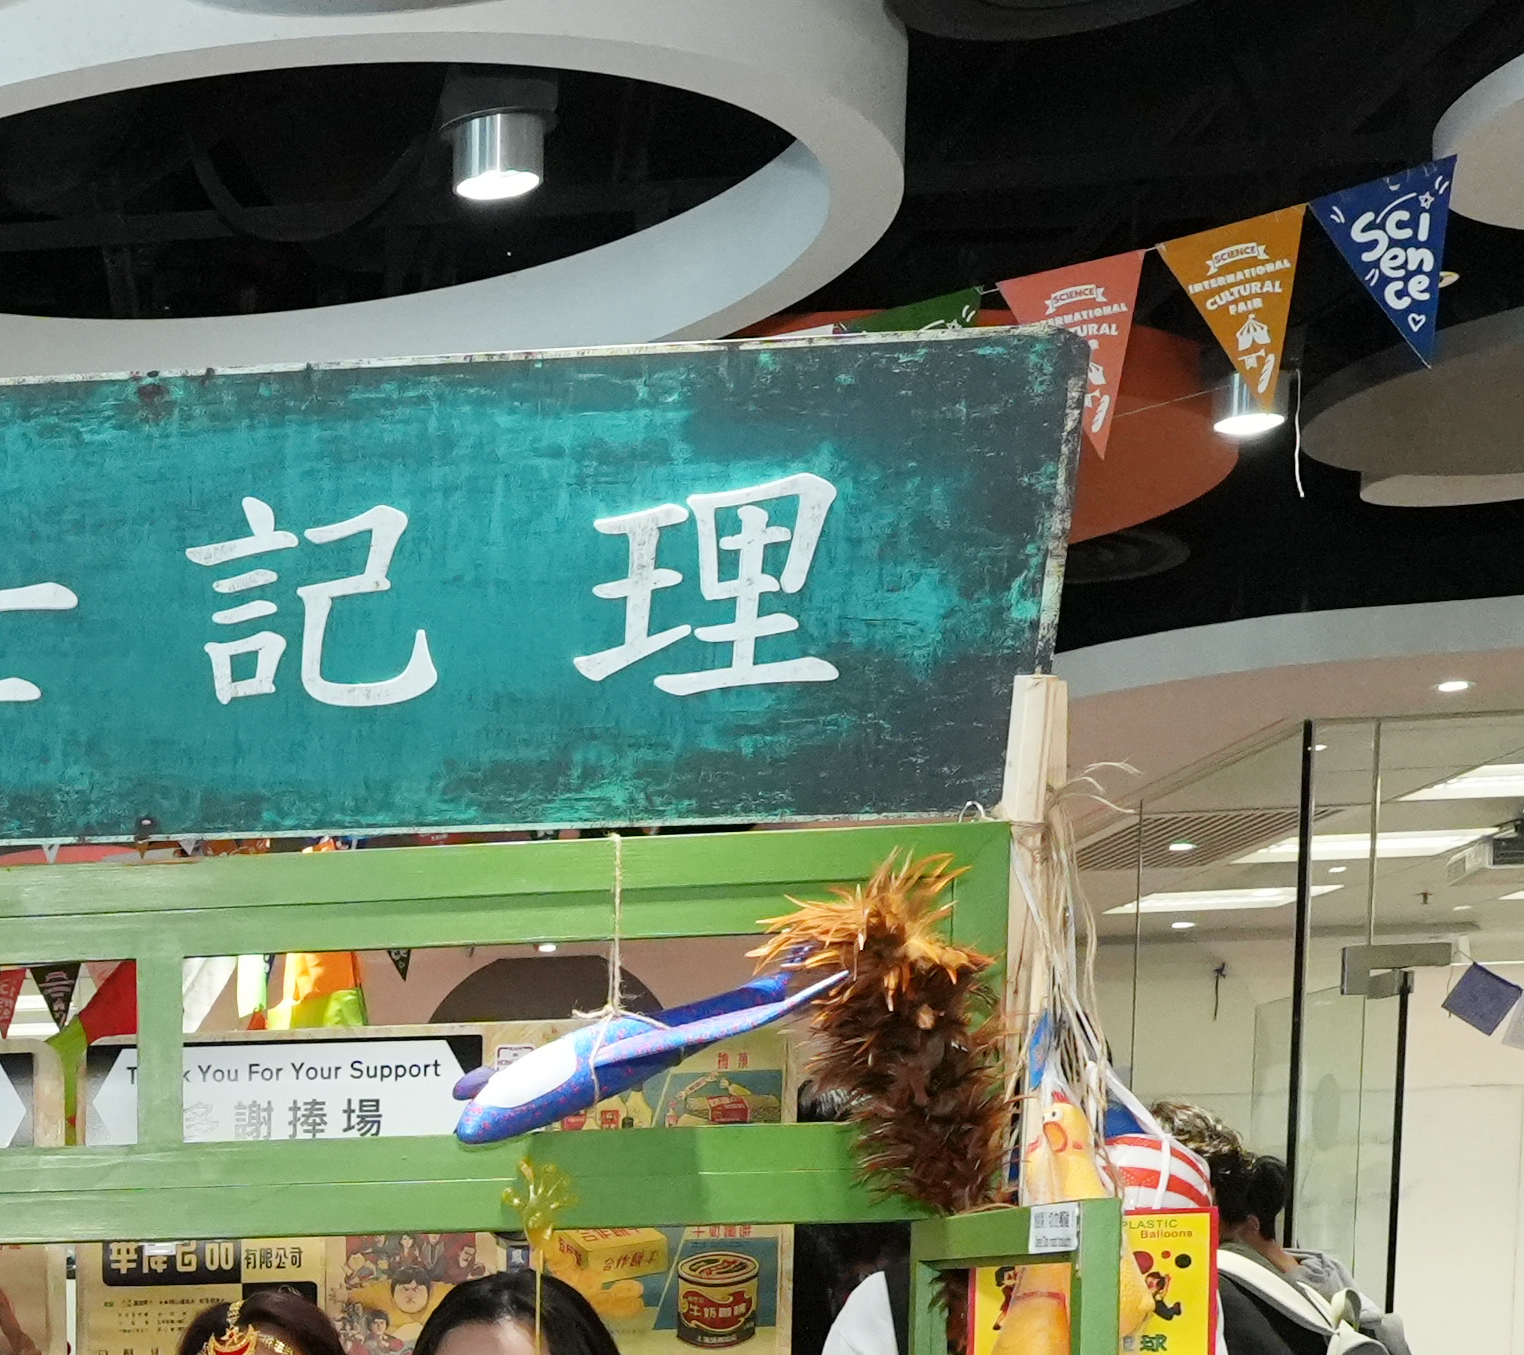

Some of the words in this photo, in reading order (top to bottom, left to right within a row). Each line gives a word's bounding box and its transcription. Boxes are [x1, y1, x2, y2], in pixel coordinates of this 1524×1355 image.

[1206, 280, 1283, 311] CULTURAL
[1230, 298, 1263, 315] FAIR
[198, 1064, 239, 1083] You
[249, 1062, 284, 1082] For
[290, 1061, 342, 1082] Your
[349, 1060, 441, 1085] Support
